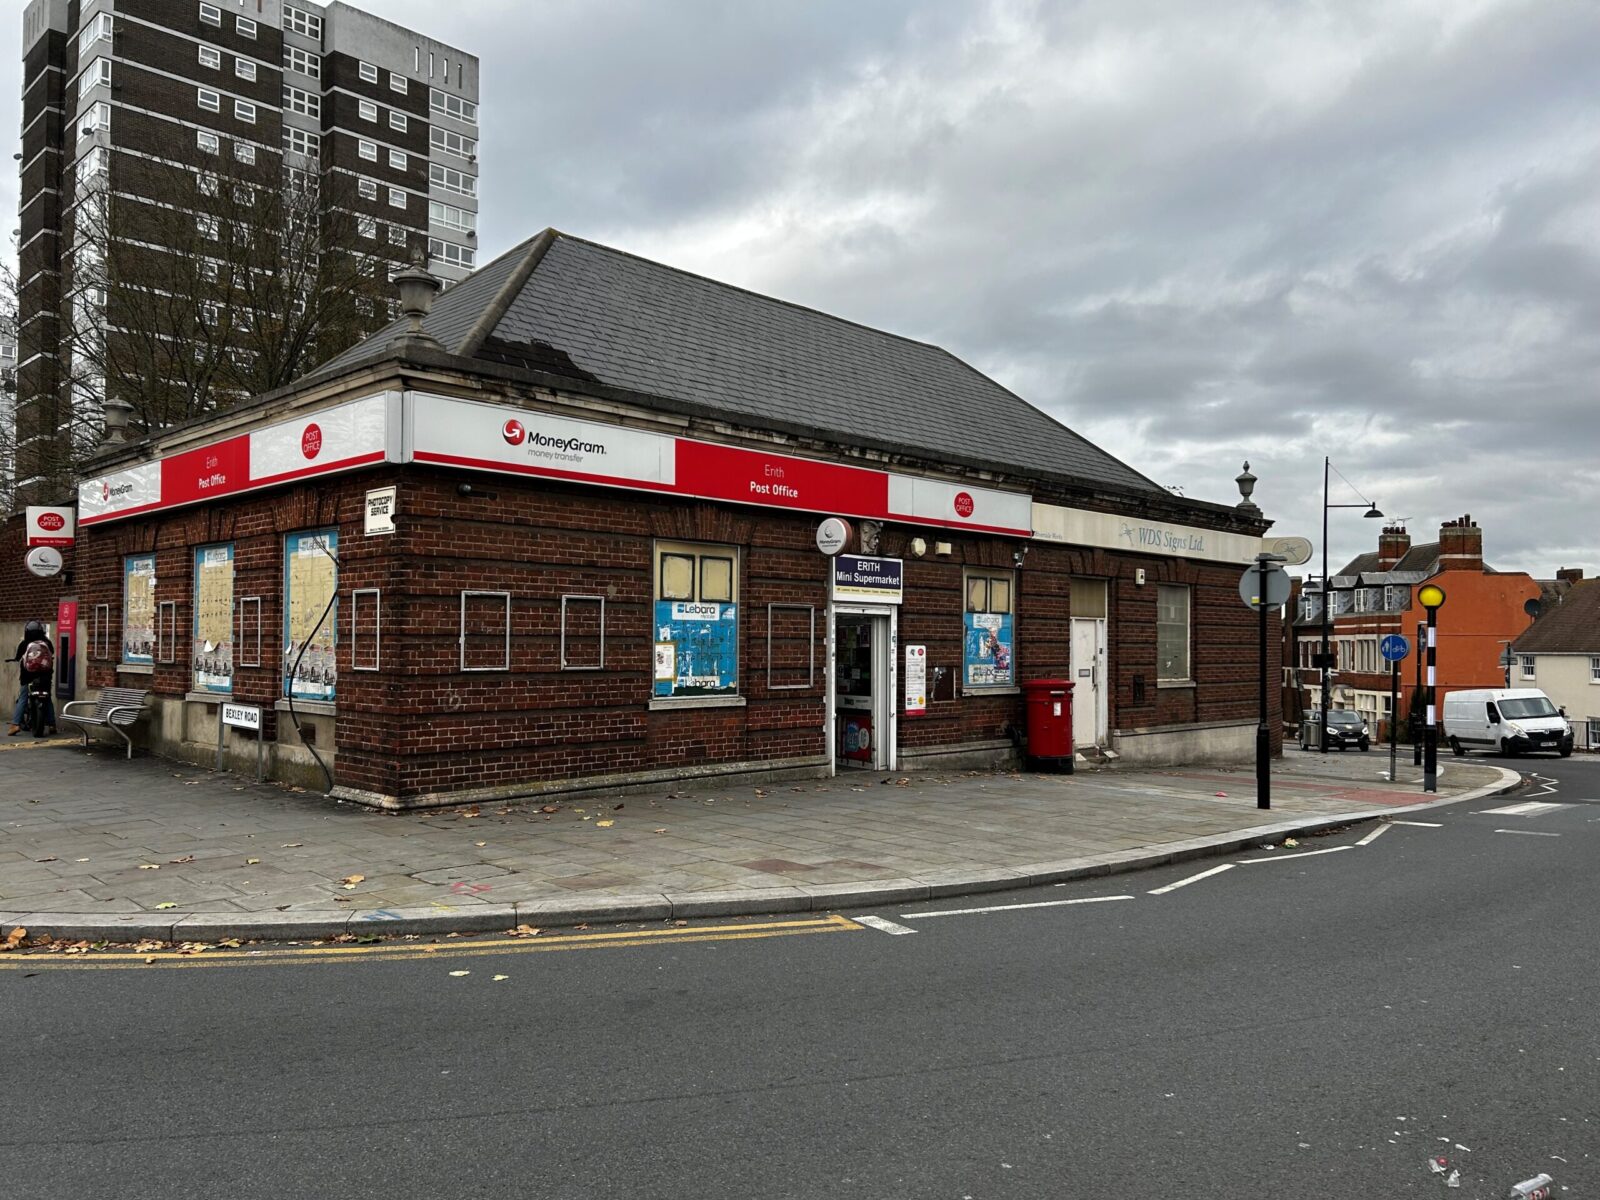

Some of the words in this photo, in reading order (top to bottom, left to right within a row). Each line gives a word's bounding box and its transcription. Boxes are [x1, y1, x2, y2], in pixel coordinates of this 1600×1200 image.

[305, 430, 319, 441] POST
[303, 438, 320, 454] OFFICE
[206, 456, 218, 469] Erith
[528, 449, 554, 460] money
[554, 452, 584, 463] transfer
[764, 464, 784, 478] Erith
[198, 477, 210, 489] Post
[210, 474, 226, 486] Office
[750, 481, 770, 494] Post
[772, 484, 798, 498] Office
[368, 496, 392, 507] PHOTOCOPY
[958, 498, 971, 506] POST
[370, 505, 388, 516] SERVICE
[956, 504, 972, 514] OFFICE
[1138, 528, 1162, 546] WDS
[1164, 531, 1188, 552] Signs
[858, 560, 880, 572] ERITH
[836, 570, 852, 582] Mini
[854, 572, 900, 585] Supermarket
[685, 604, 716, 614] Lebara
[226, 708, 244, 720] BEXLEY
[244, 711, 258, 723] ROAD
